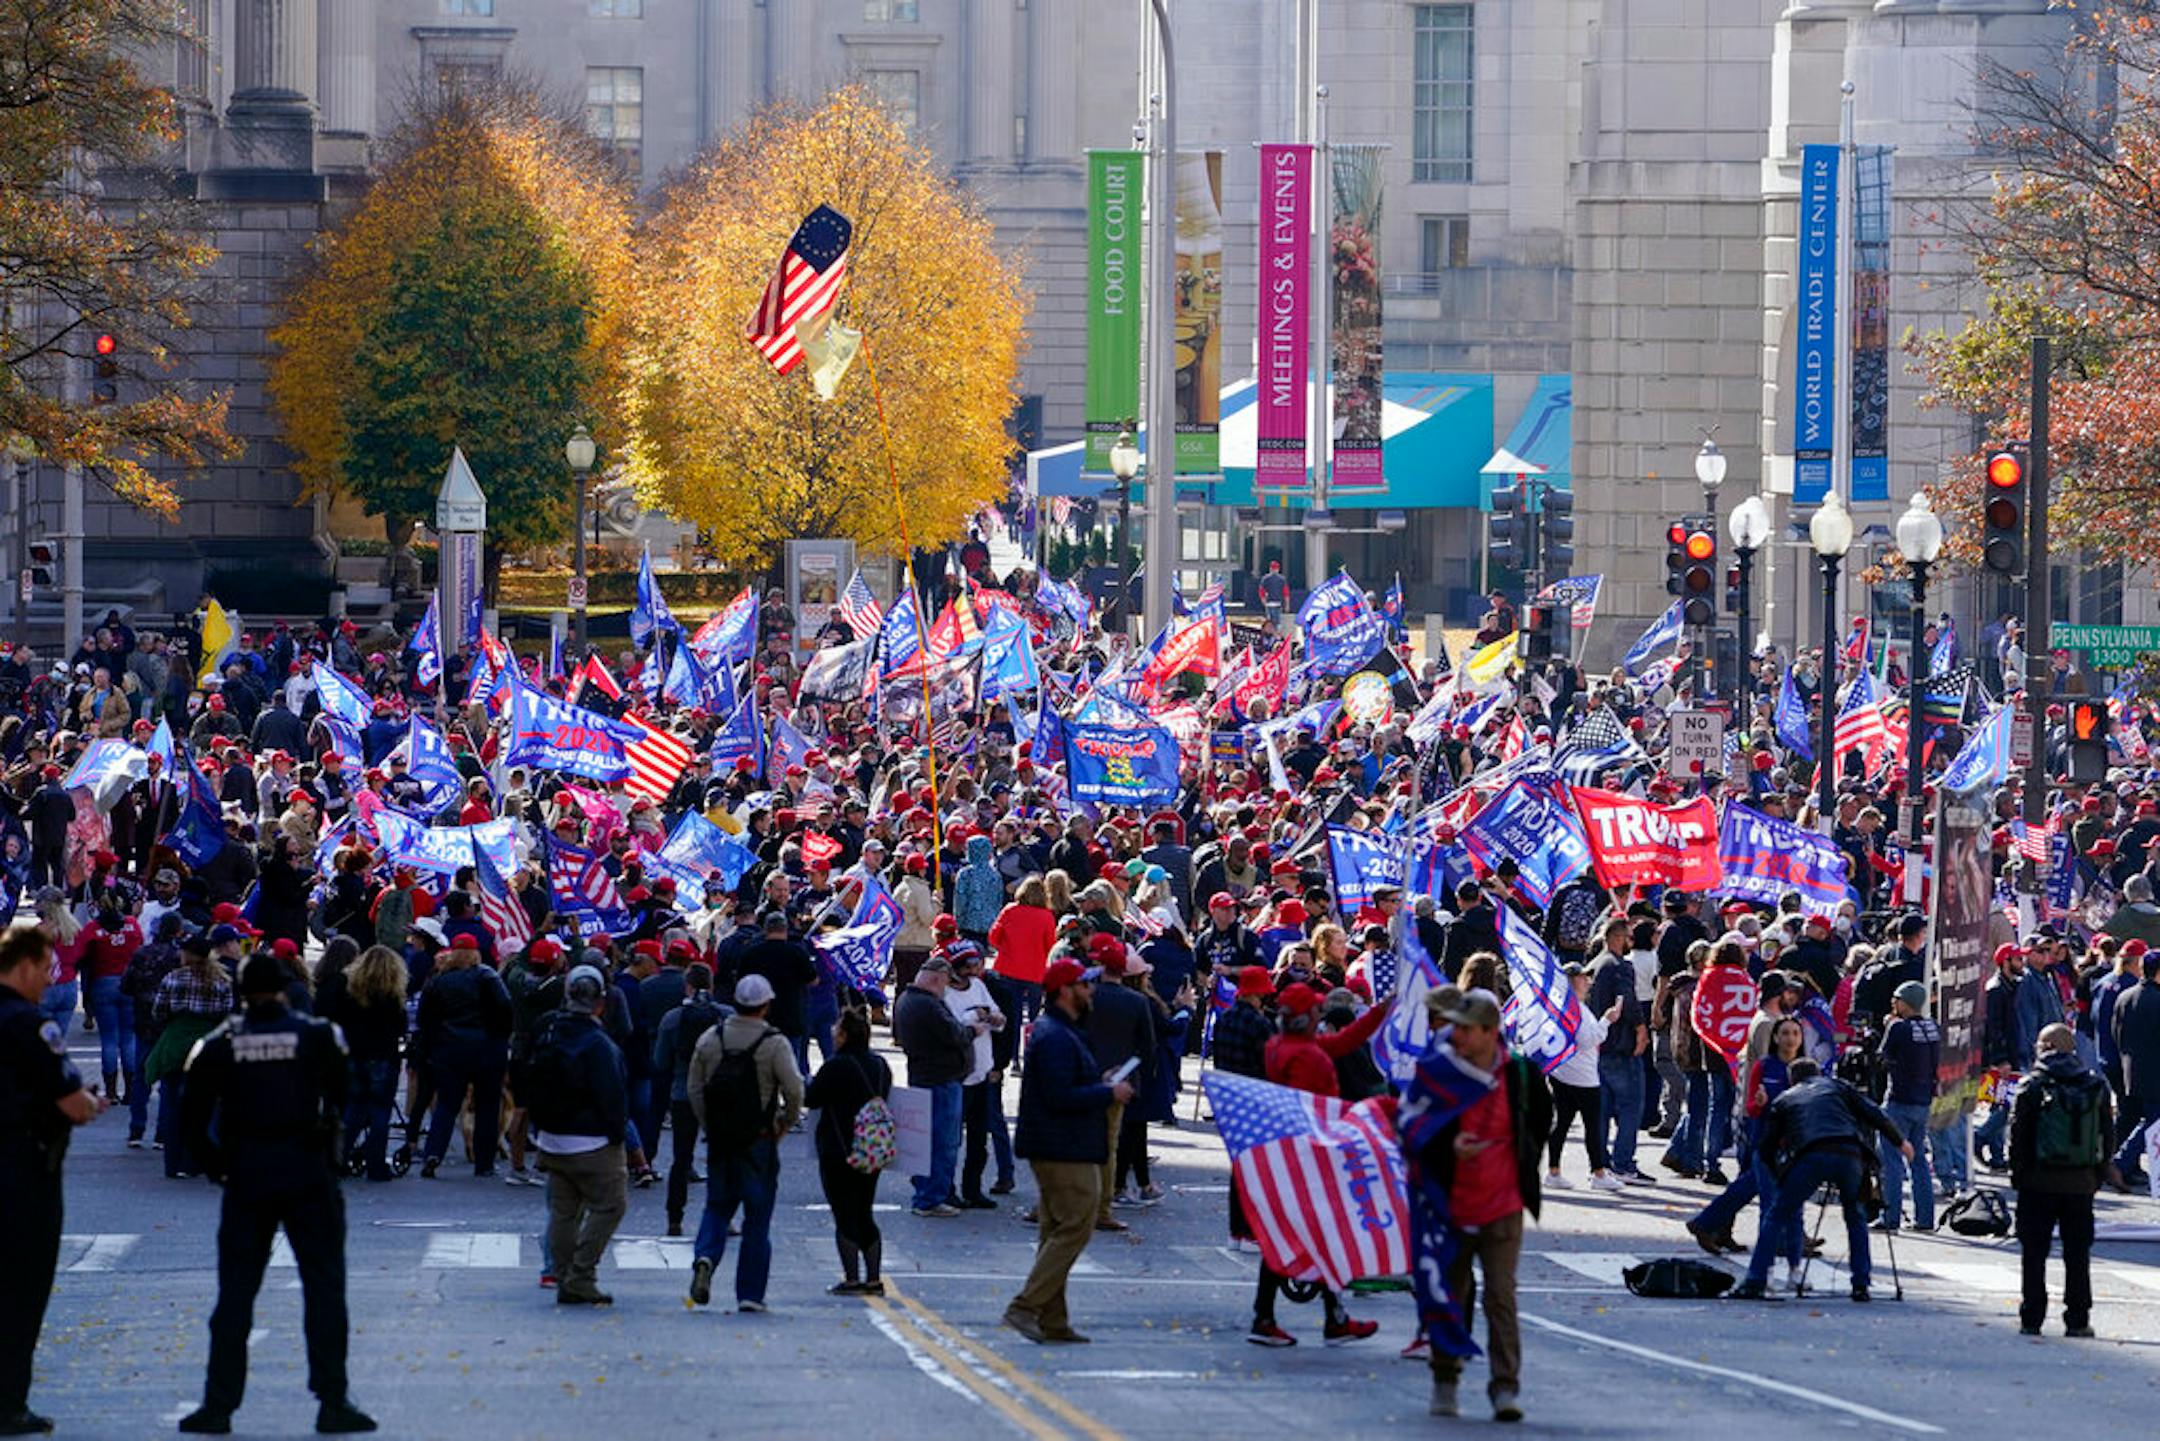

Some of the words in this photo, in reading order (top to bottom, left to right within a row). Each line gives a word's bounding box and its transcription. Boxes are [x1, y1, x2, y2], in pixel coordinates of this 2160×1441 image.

[1105, 165, 1127, 242] COURT
[1274, 151, 1297, 244] EVENTS
[1809, 160, 1828, 257] CENTER
[1104, 248, 1125, 315] FOOD
[1273, 251, 1295, 270] &
[1807, 265, 1825, 342] TRADE
[1272, 278, 1295, 408] MEETINGS
[1804, 349, 1822, 443] WORLD
[2053, 627, 2152, 648] PENNSYLVANIA
[2093, 649, 2131, 664] 1300
[1674, 746, 1690, 757] ON
[1696, 746, 1718, 758] RED
[1681, 732, 1712, 743] TURN
[1685, 717, 1708, 730] NO
